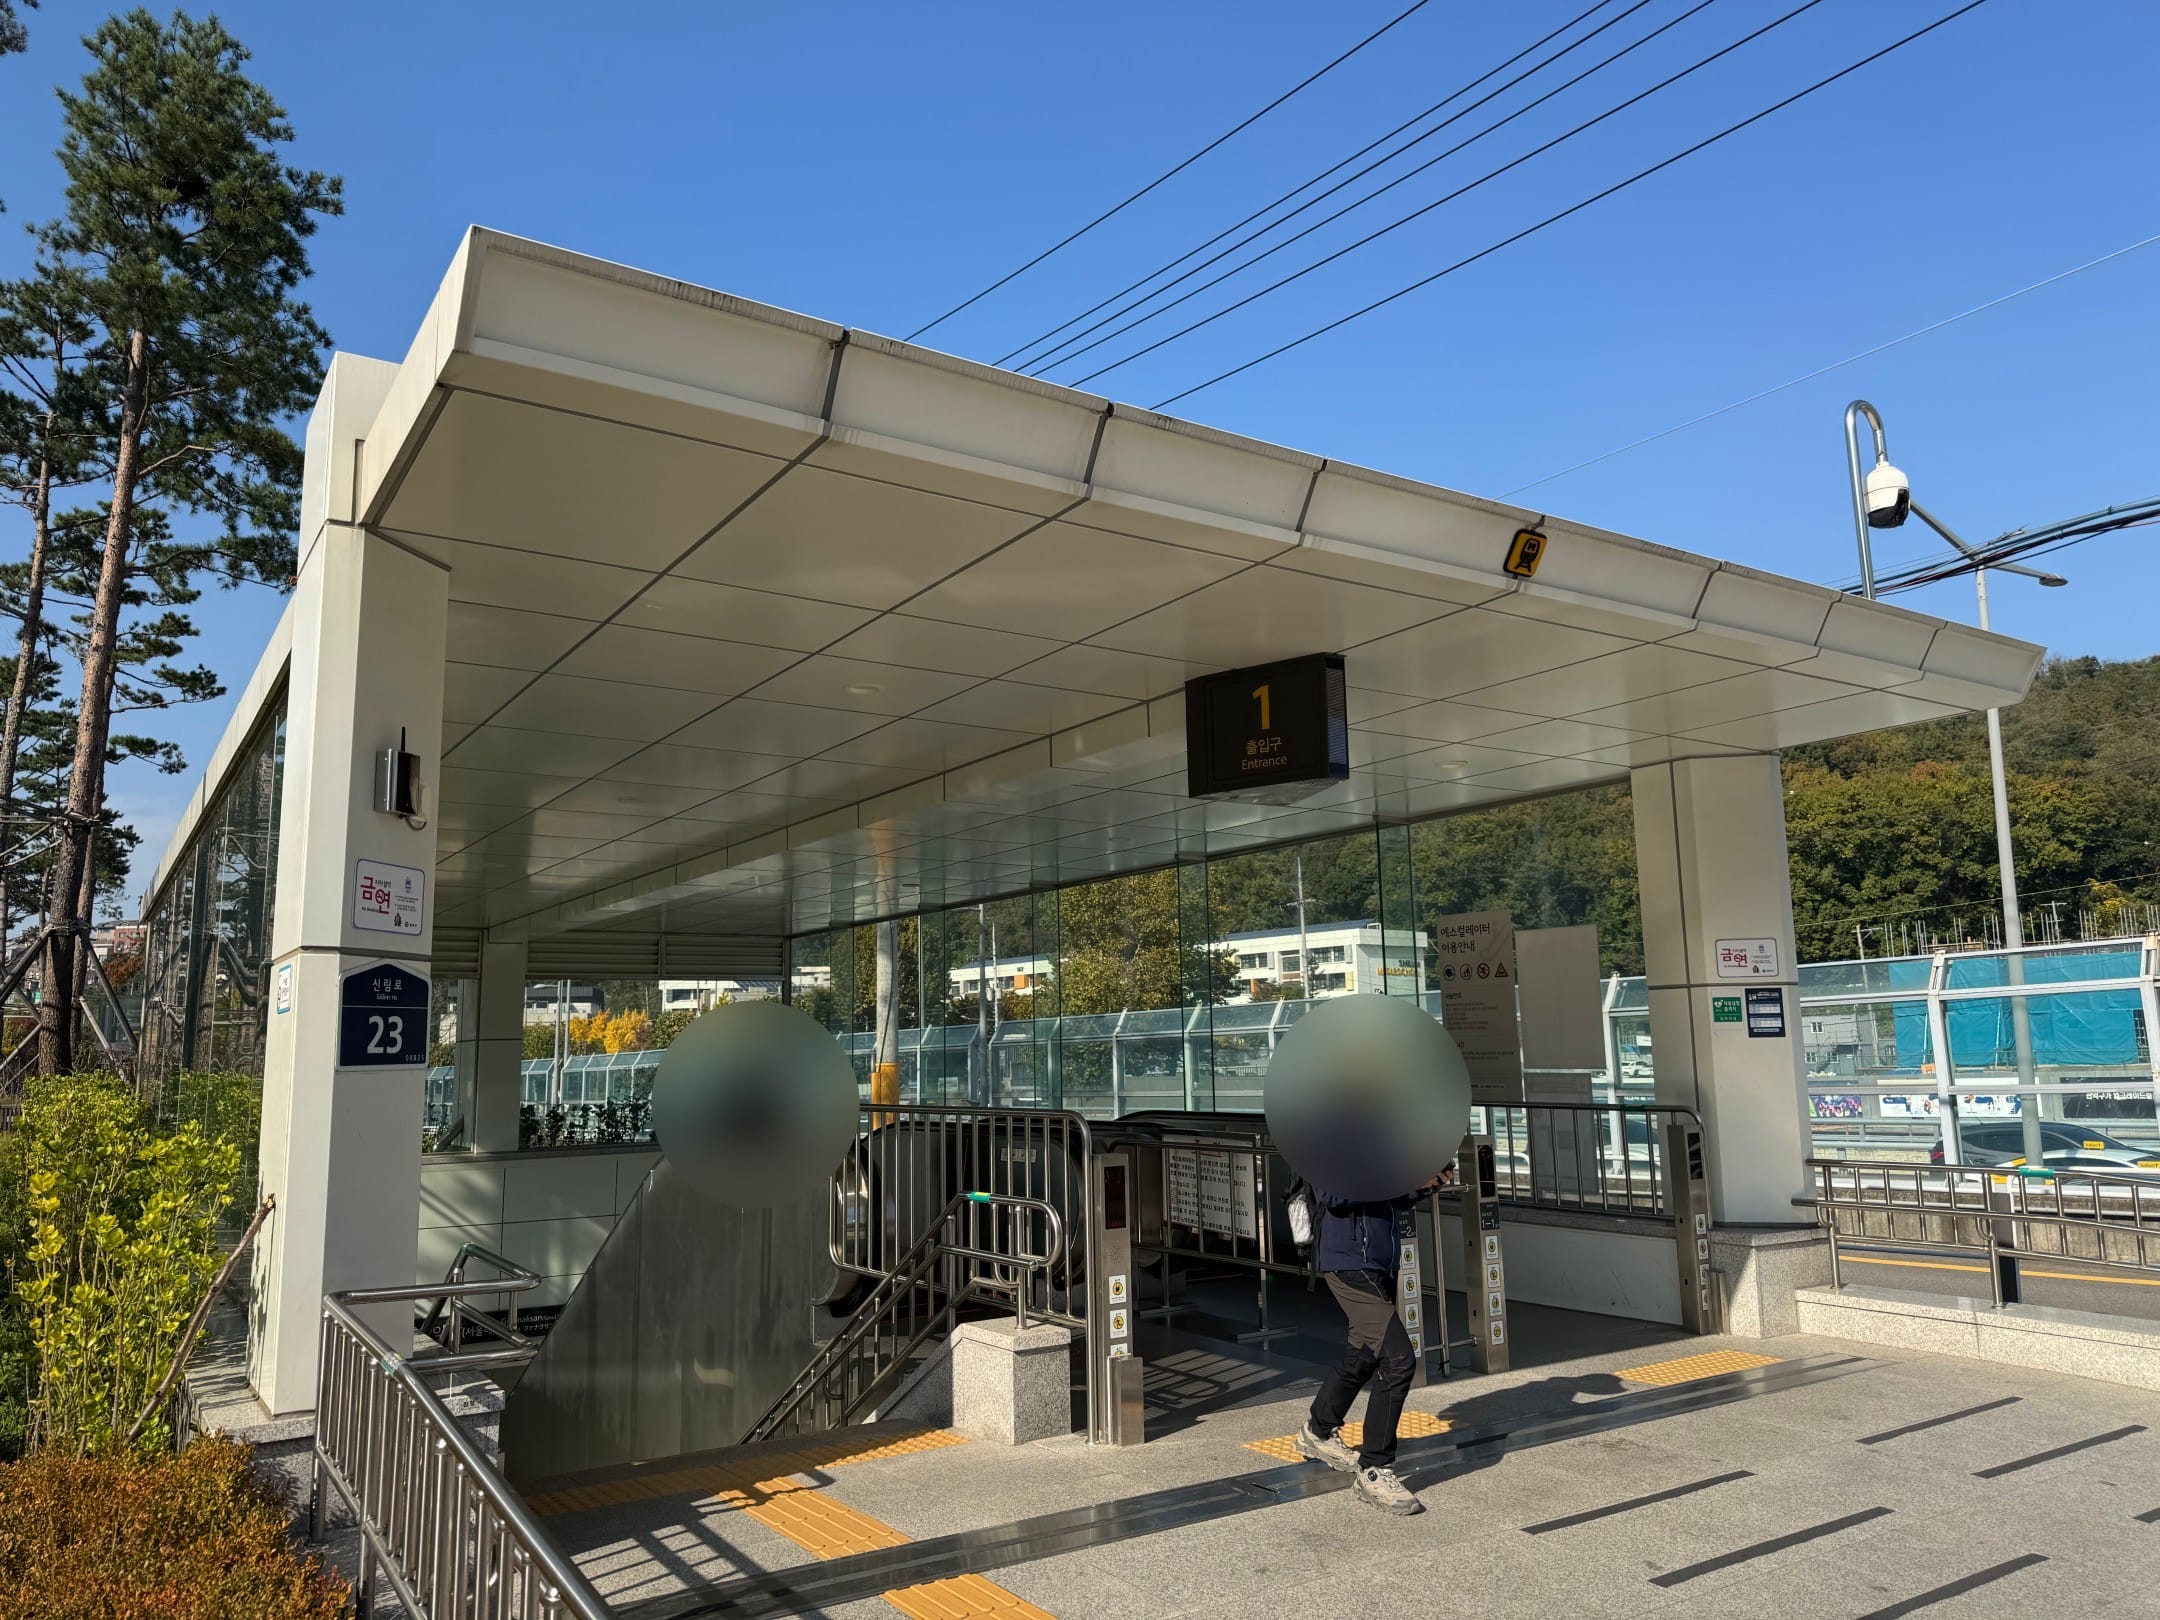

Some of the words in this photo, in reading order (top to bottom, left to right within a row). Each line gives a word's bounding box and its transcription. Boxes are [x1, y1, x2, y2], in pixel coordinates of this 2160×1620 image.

[1252, 684, 1270, 731] 1
[1246, 736, 1282, 755] 출입구
[1242, 754, 1288, 770] Entrance
[360, 876, 391, 914] 금연
[1440, 922, 1490, 938] 에스컬레이터
[1441, 939, 1475, 954] 이용안내
[1720, 948, 1748, 968] 금연
[372, 977, 403, 993] 신림로
[366, 1014, 404, 1055] 23
